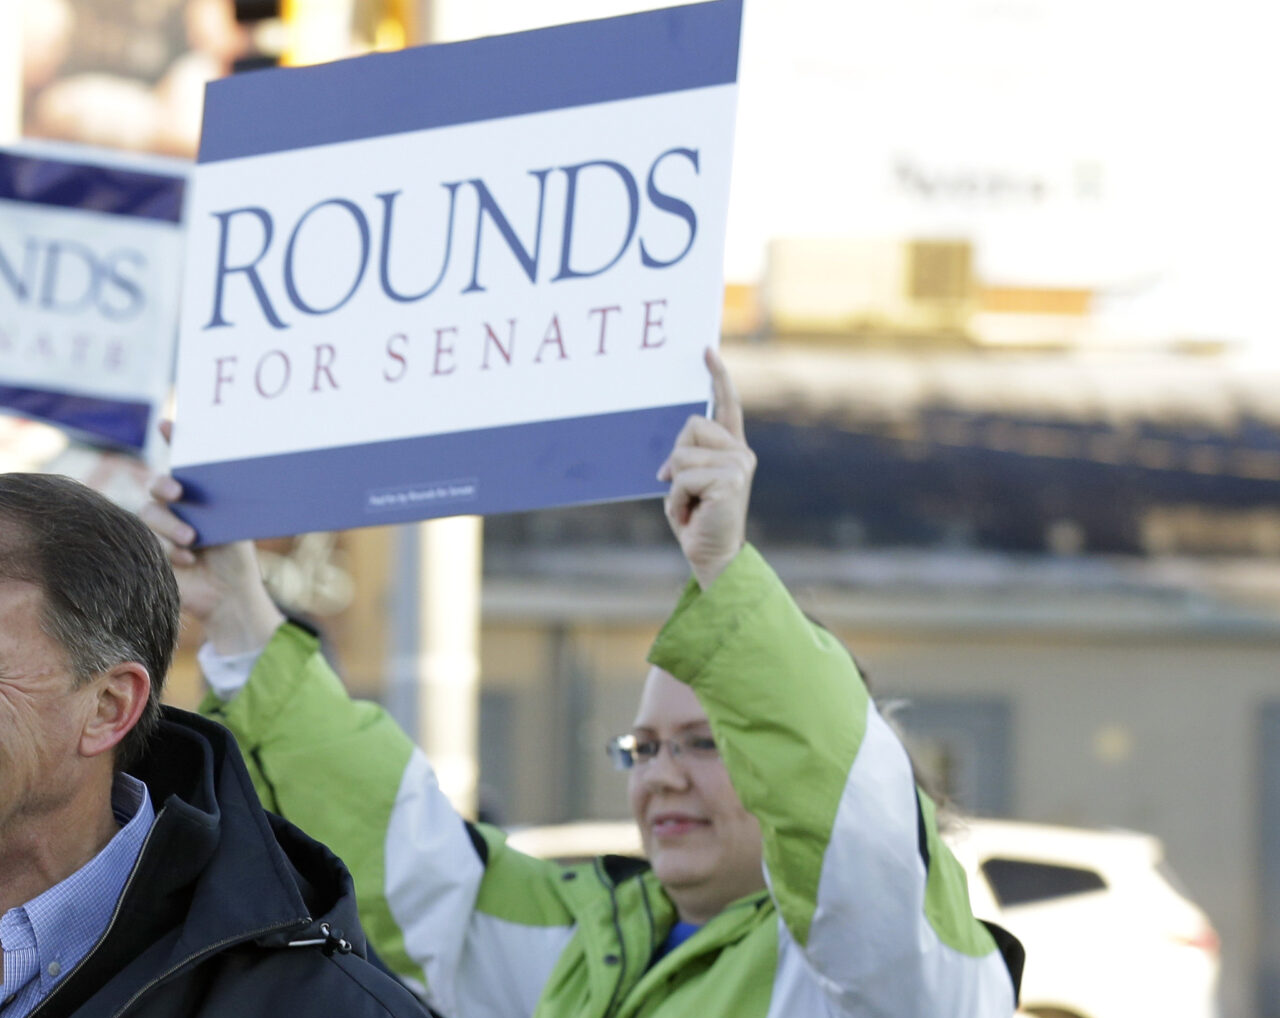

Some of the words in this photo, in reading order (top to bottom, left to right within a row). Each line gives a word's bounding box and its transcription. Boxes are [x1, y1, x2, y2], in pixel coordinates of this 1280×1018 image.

[202, 147, 701, 331] ROUNDS
[210, 343, 341, 406] FOR
[382, 298, 669, 384] SENATE
